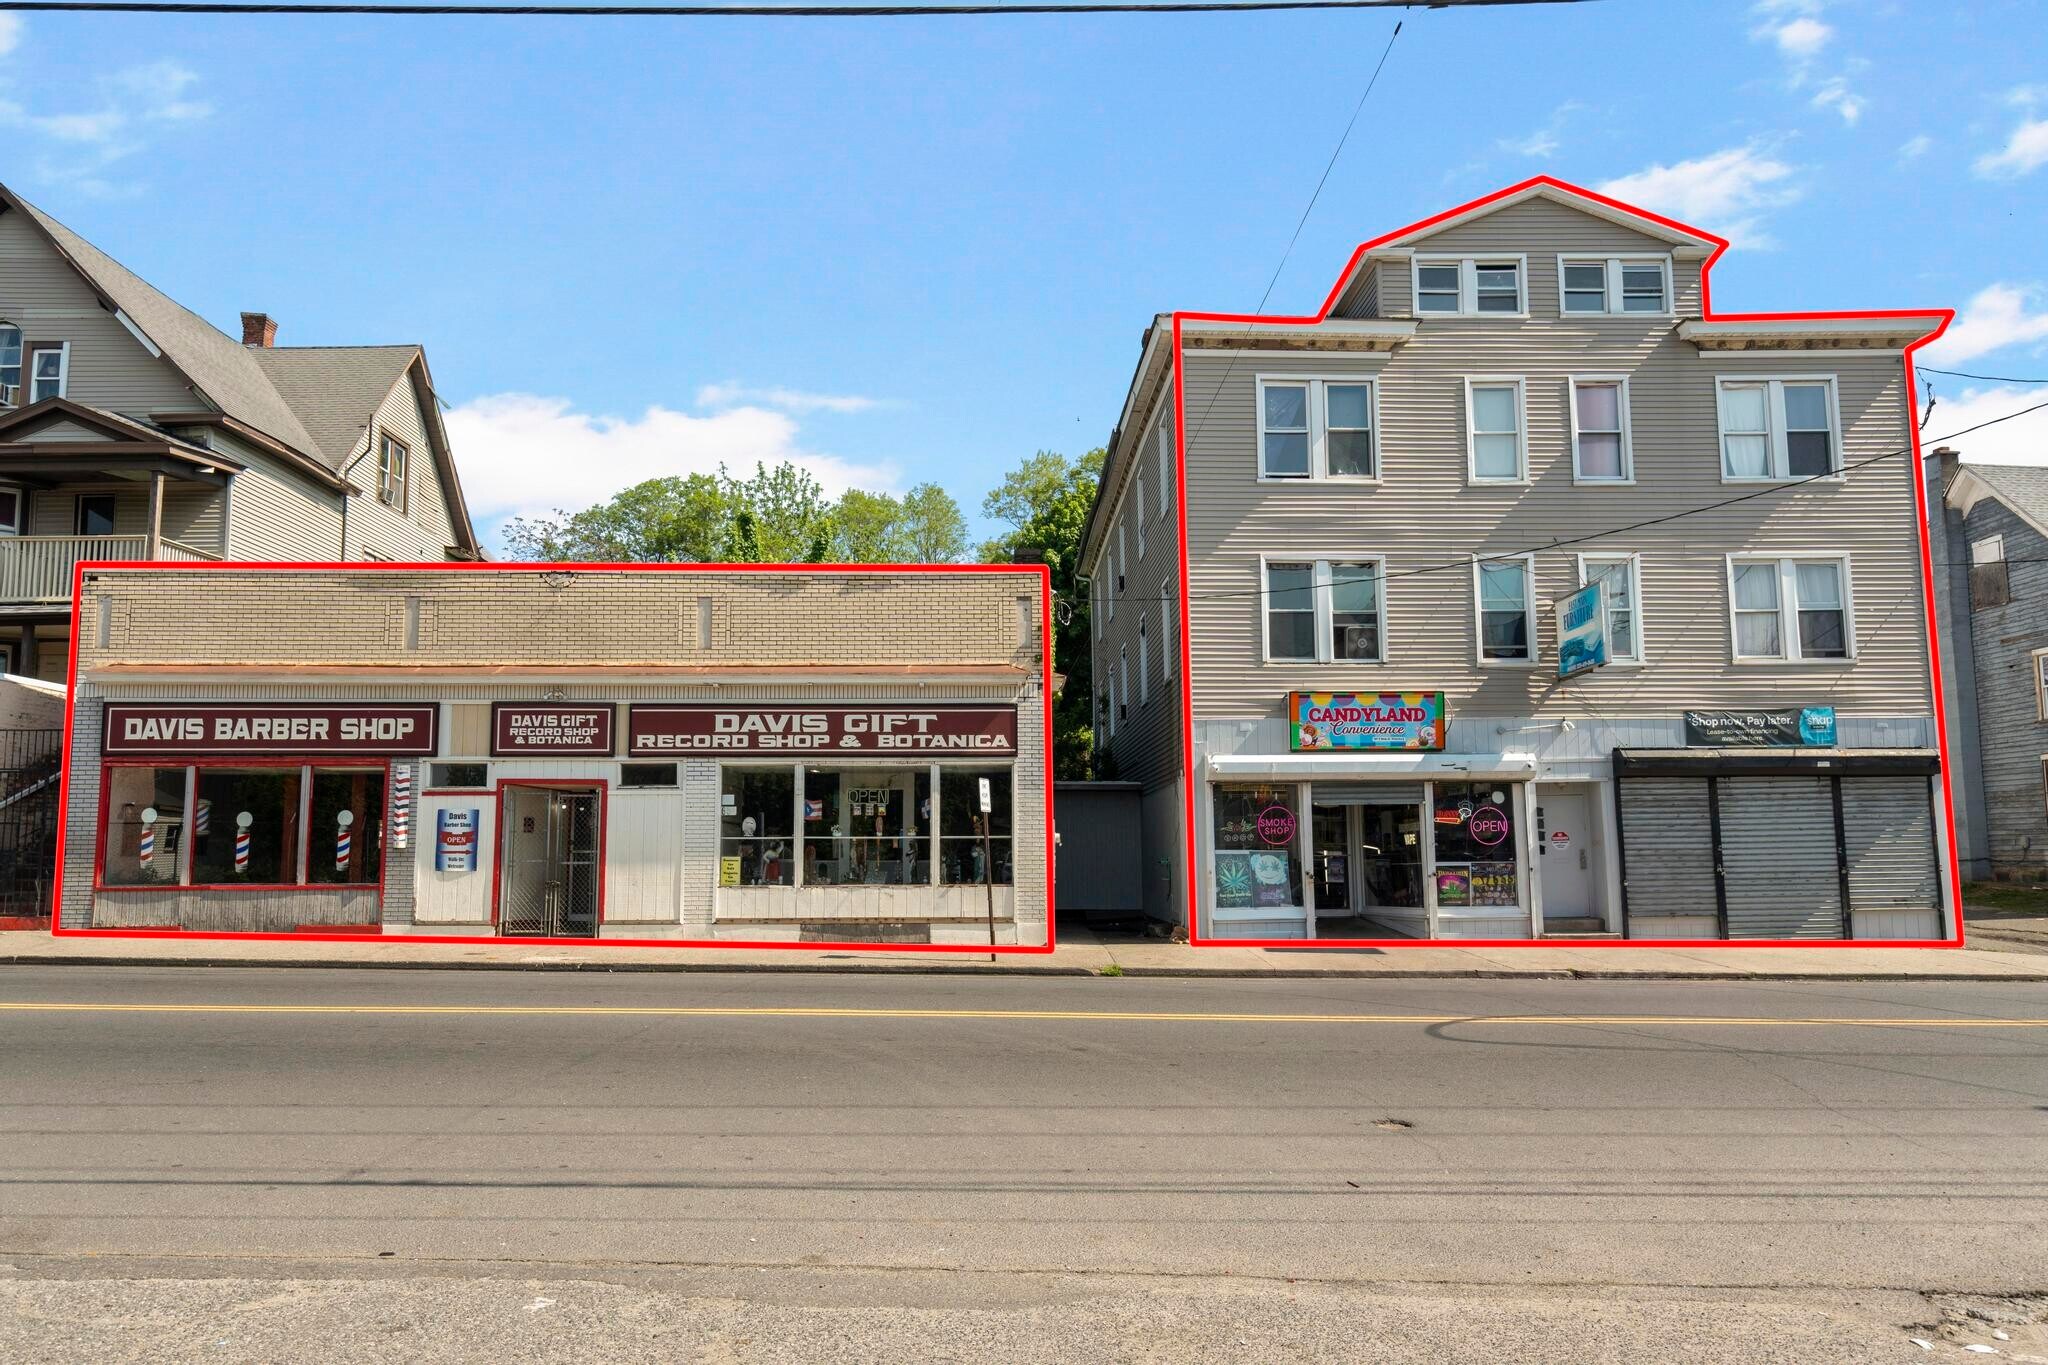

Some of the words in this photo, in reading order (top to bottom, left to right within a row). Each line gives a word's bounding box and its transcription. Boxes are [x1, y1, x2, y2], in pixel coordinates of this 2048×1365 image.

[1563, 604, 1593, 630] FURNITURE
[511, 715, 558, 727] DAVIS
[560, 715, 598, 727] GIFT
[1309, 707, 1426, 722] CANDYLAND
[1691, 716, 1719, 728] Shop
[1720, 717, 1745, 727] now.
[1747, 716, 1766, 727] Pay
[1767, 715, 1794, 726] later.
[124, 718, 203, 740] DAVIS
[214, 718, 329, 740] BARBER
[340, 718, 415, 740] SHOP
[714, 714, 829, 733] DAVIS
[843, 714, 938, 733] GIFT
[1330, 721, 1405, 736] Convenience
[1807, 715, 1834, 729] snap
[509, 727, 562, 736] RECORD
[564, 727, 599, 736] SHOP
[514, 736, 526, 744] &
[528, 736, 593, 745] BOTANICA
[636, 734, 749, 748] RECORD
[758, 734, 831, 748] SHOP
[839, 734, 862, 748] &
[877, 734, 1010, 748] BOTANICA
[848, 789, 888, 803] OPEN
[1260, 818, 1293, 827] SMOKE
[1473, 821, 1506, 832] OPEN
[1264, 827, 1290, 835] SHOP
